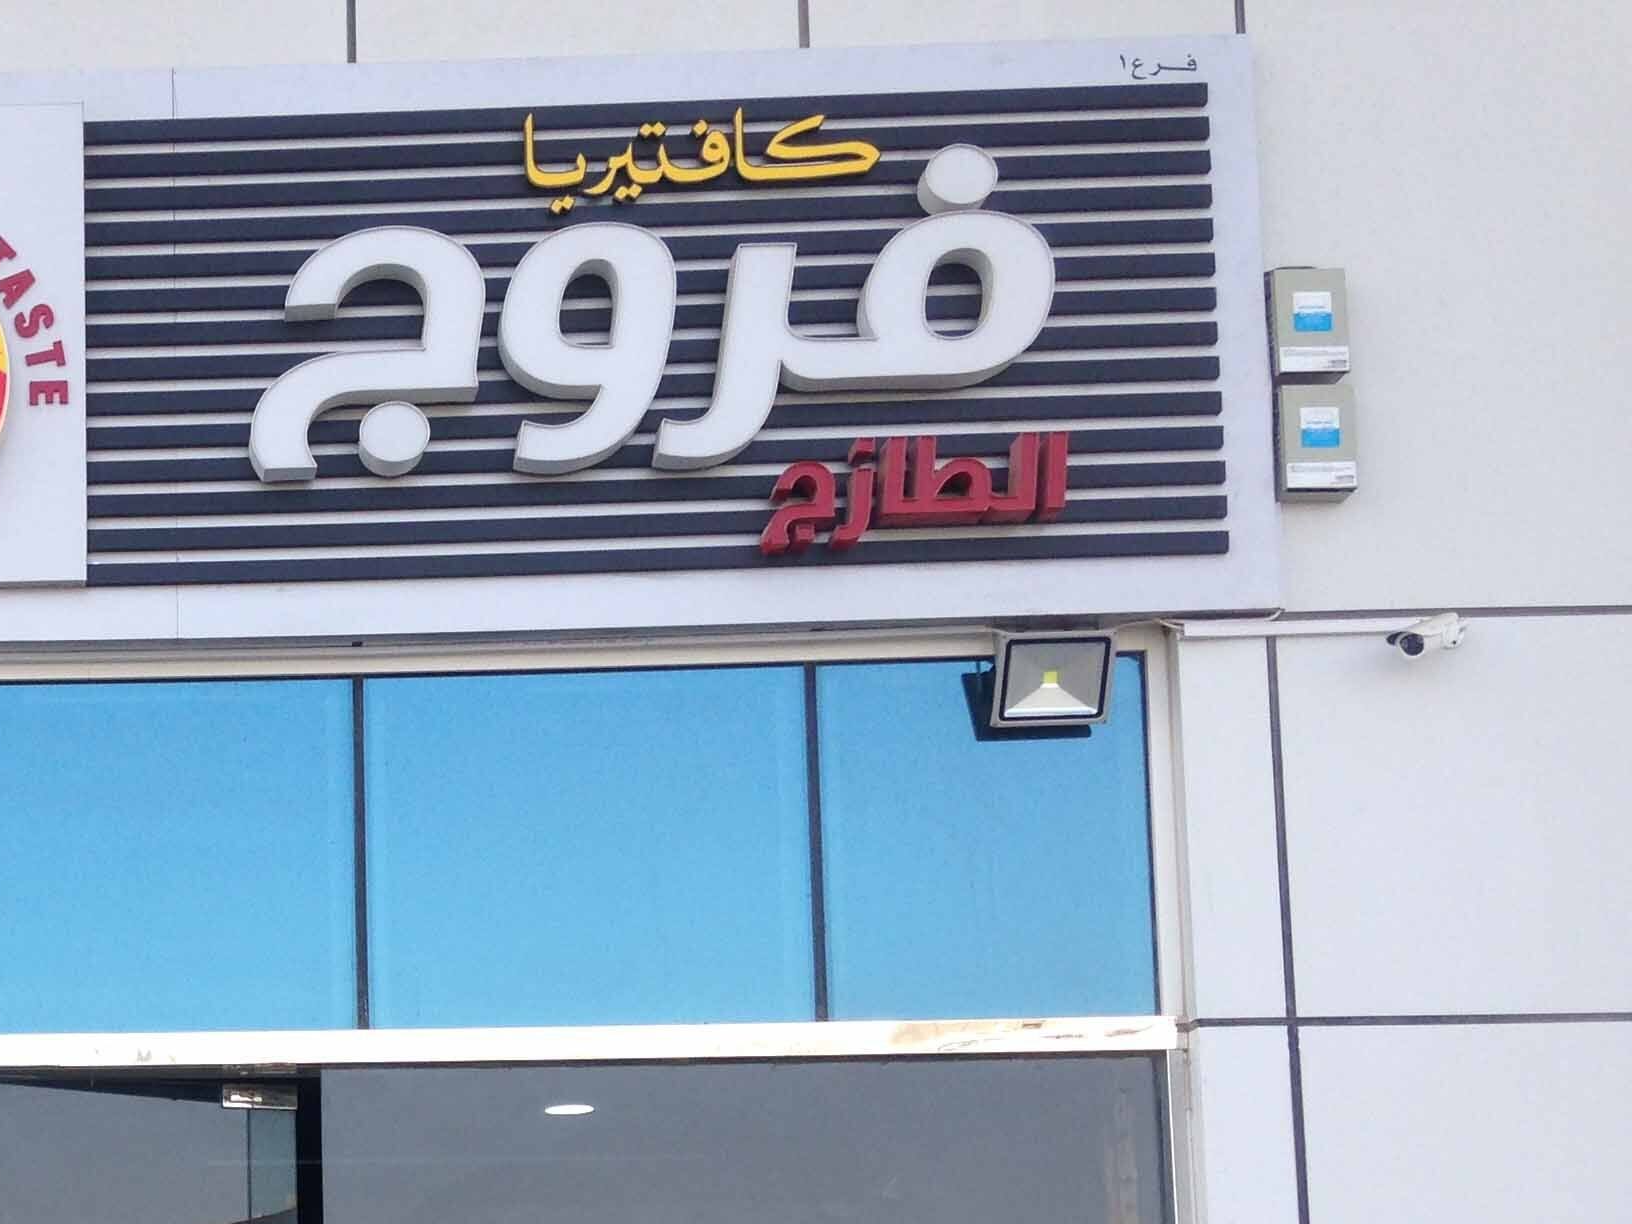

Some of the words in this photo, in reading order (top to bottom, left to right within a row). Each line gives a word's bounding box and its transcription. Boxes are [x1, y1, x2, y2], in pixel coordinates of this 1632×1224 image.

[523, 106, 881, 215] كافتيريا
[248, 143, 1056, 484] فروج
[758, 431, 1070, 555] الطازج
